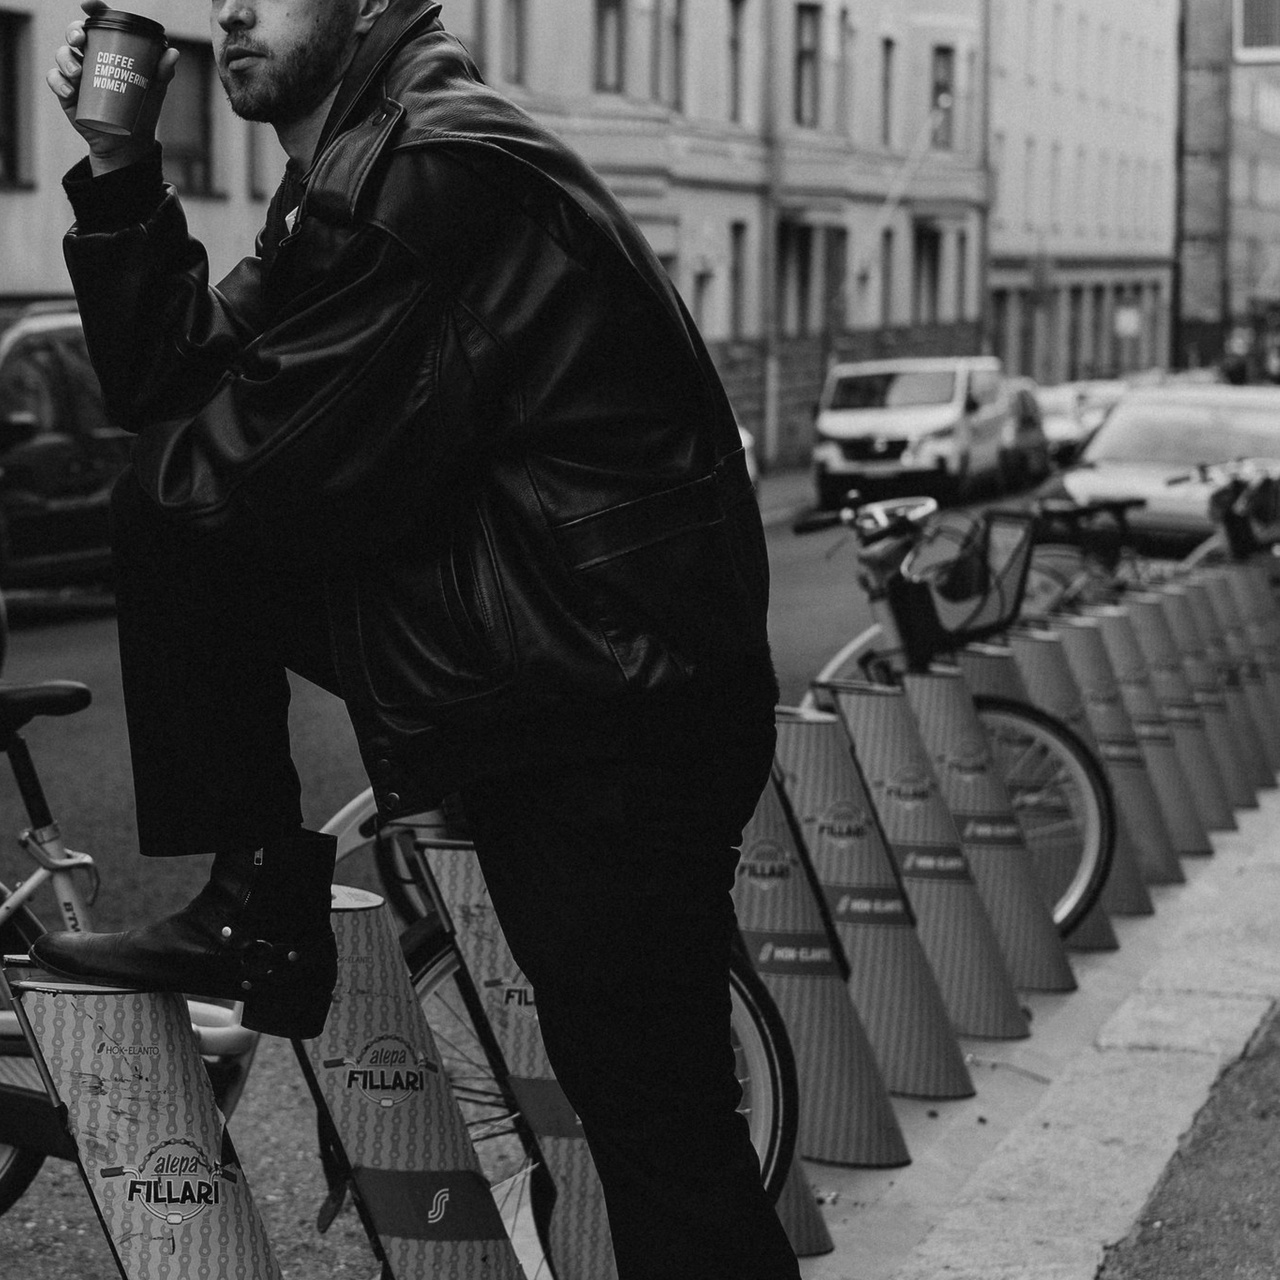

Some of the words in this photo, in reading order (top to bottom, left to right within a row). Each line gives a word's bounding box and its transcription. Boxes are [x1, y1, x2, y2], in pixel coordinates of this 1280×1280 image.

[97, 51, 135, 69] COFFEE
[93, 76, 127, 94] WOMEN
[106, 1046, 160, 1056] HOK-ELANTO
[369, 1048, 407, 1067] alepa
[347, 1069, 424, 1091] FILLARI
[153, 1153, 199, 1176] alepa
[127, 1179, 220, 1205] FILLARI
